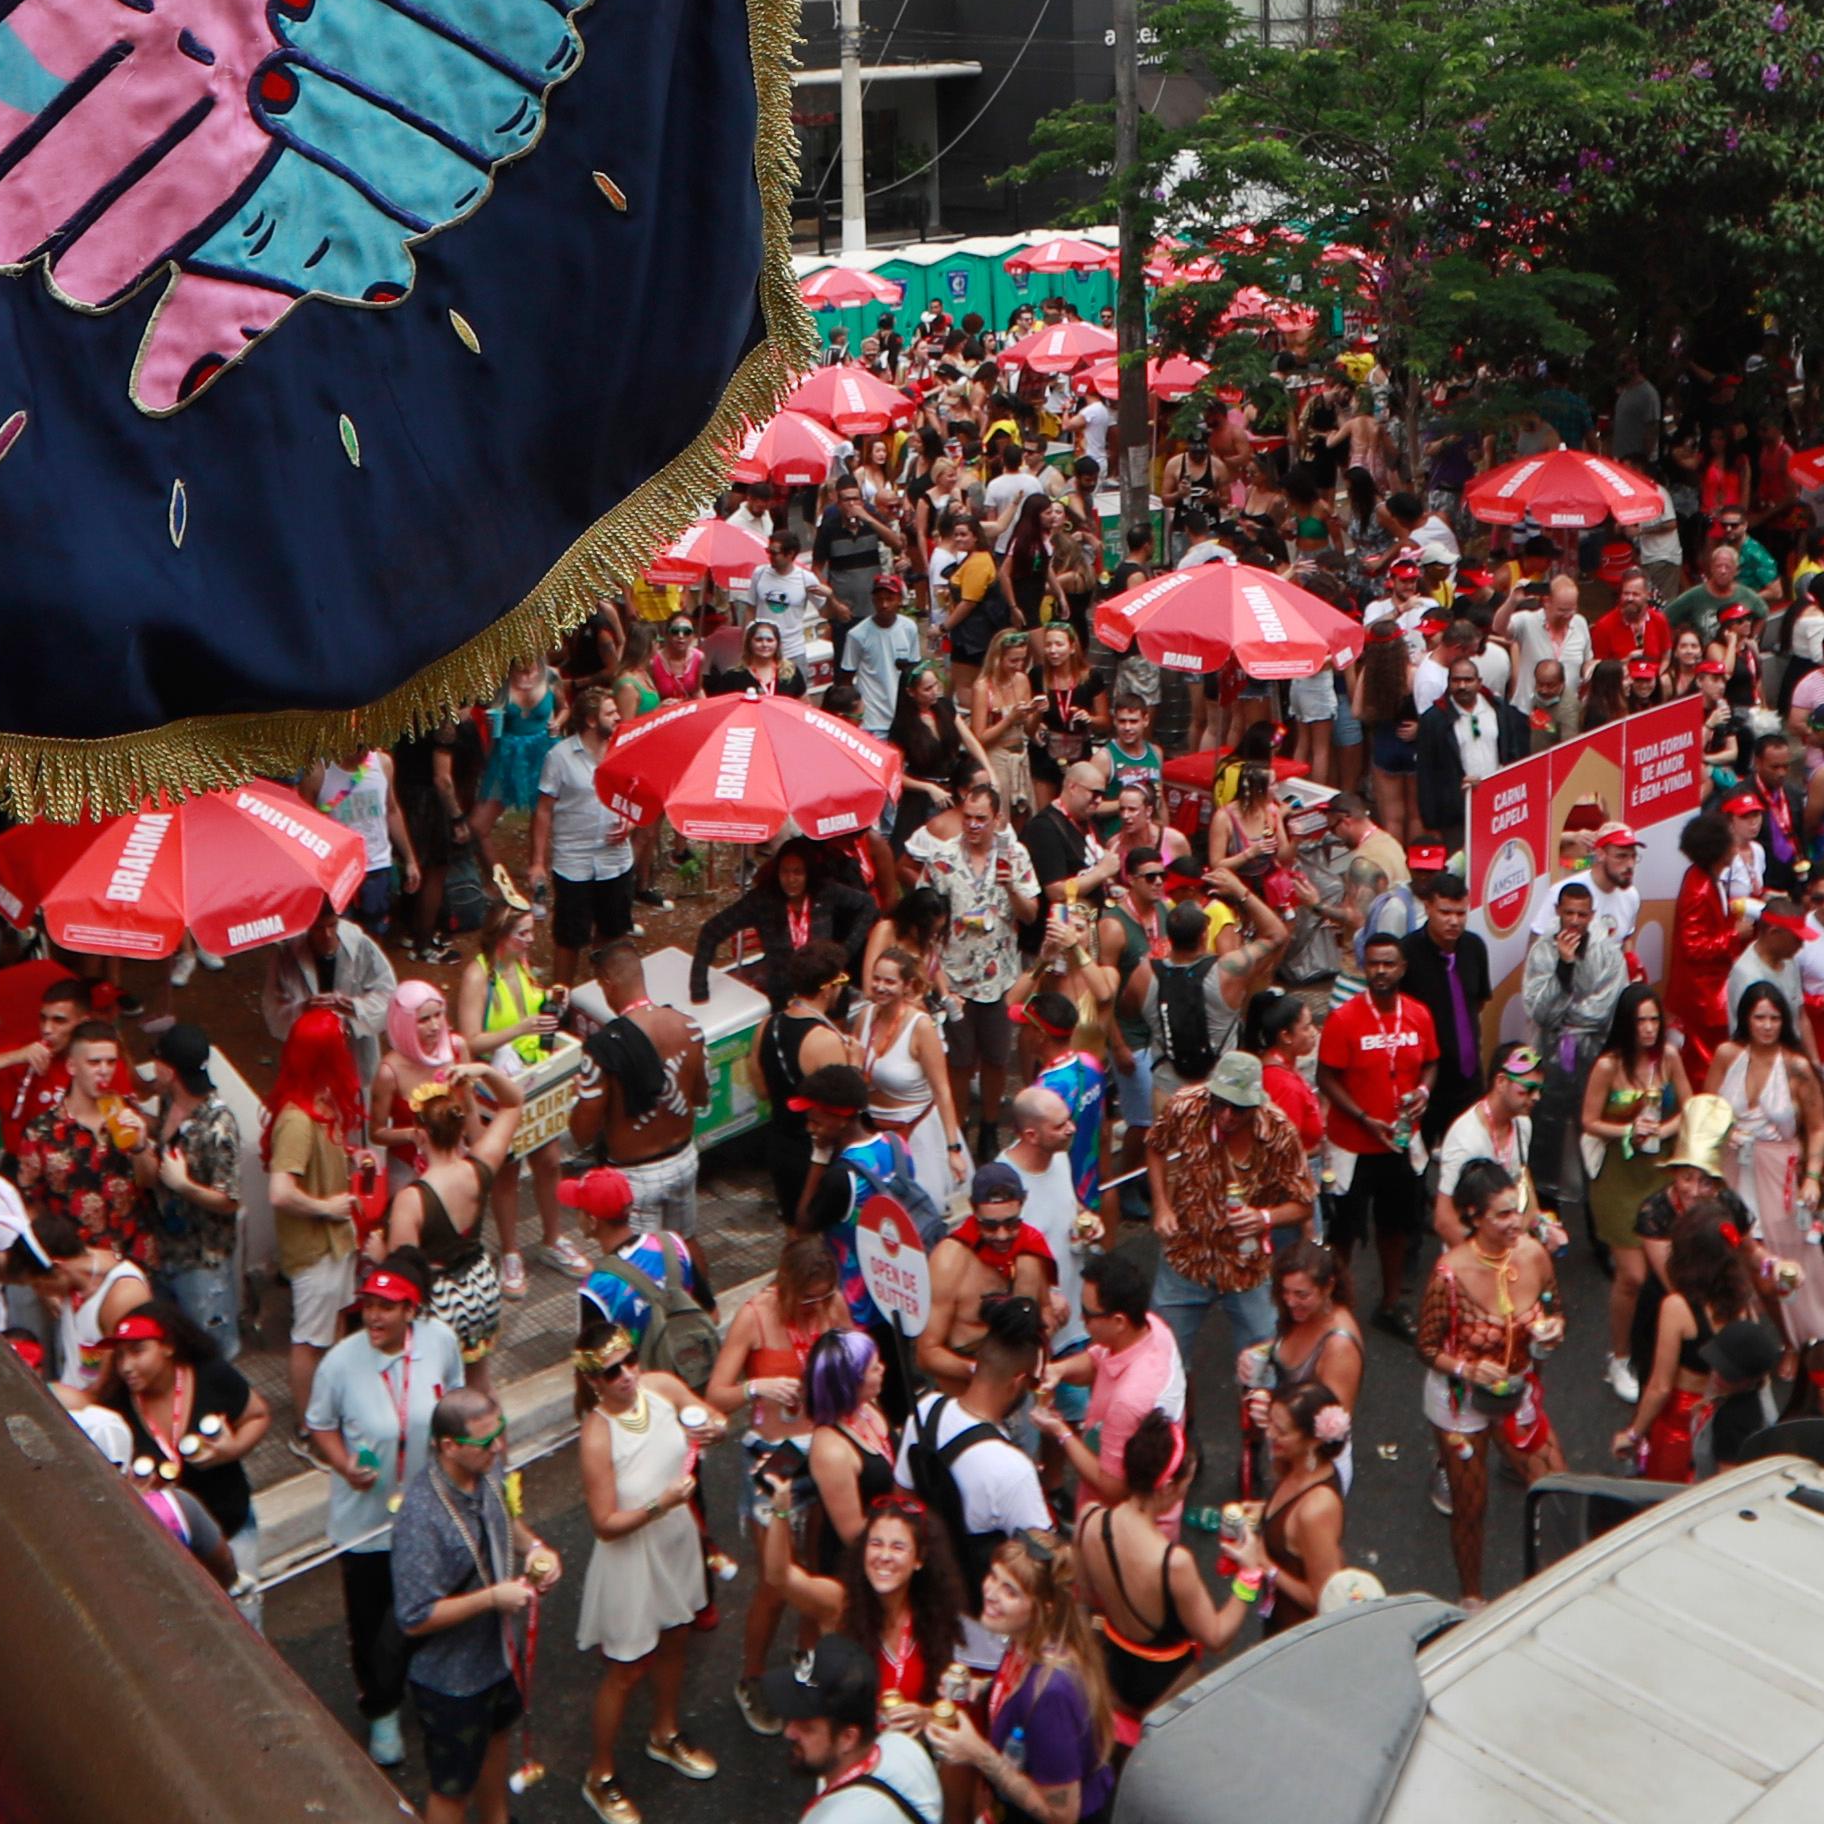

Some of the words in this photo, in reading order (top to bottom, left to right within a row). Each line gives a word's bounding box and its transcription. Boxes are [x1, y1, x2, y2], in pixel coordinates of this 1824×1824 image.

[1121, 573, 1192, 617] BRAHMA
[1241, 585, 1288, 643] BRAHMA
[1162, 651, 1203, 670] BRAHMA
[615, 703, 698, 747] BRAHMA
[803, 710, 884, 768] BRAHMA
[714, 726, 757, 800] BRAHMA
[1632, 744, 1660, 767] TODA
[1660, 730, 1695, 759] FORMA
[1639, 770, 1694, 804] BEM-VINDA
[1640, 765, 1655, 783] DE
[1656, 753, 1686, 780] AMOR
[1493, 782, 1528, 813] CARNA
[236, 792, 332, 860] BRAHMA
[816, 812, 859, 835] BRAHMA
[1490, 803, 1529, 836] CAPELA
[105, 813, 174, 903] BRAHMA
[1492, 869, 1527, 898] AMSTEL
[228, 913, 286, 947] BRAHMA
[870, 1256, 899, 1288] OPEN
[901, 1269, 917, 1295] DE
[874, 1280, 920, 1319] GLITTER
